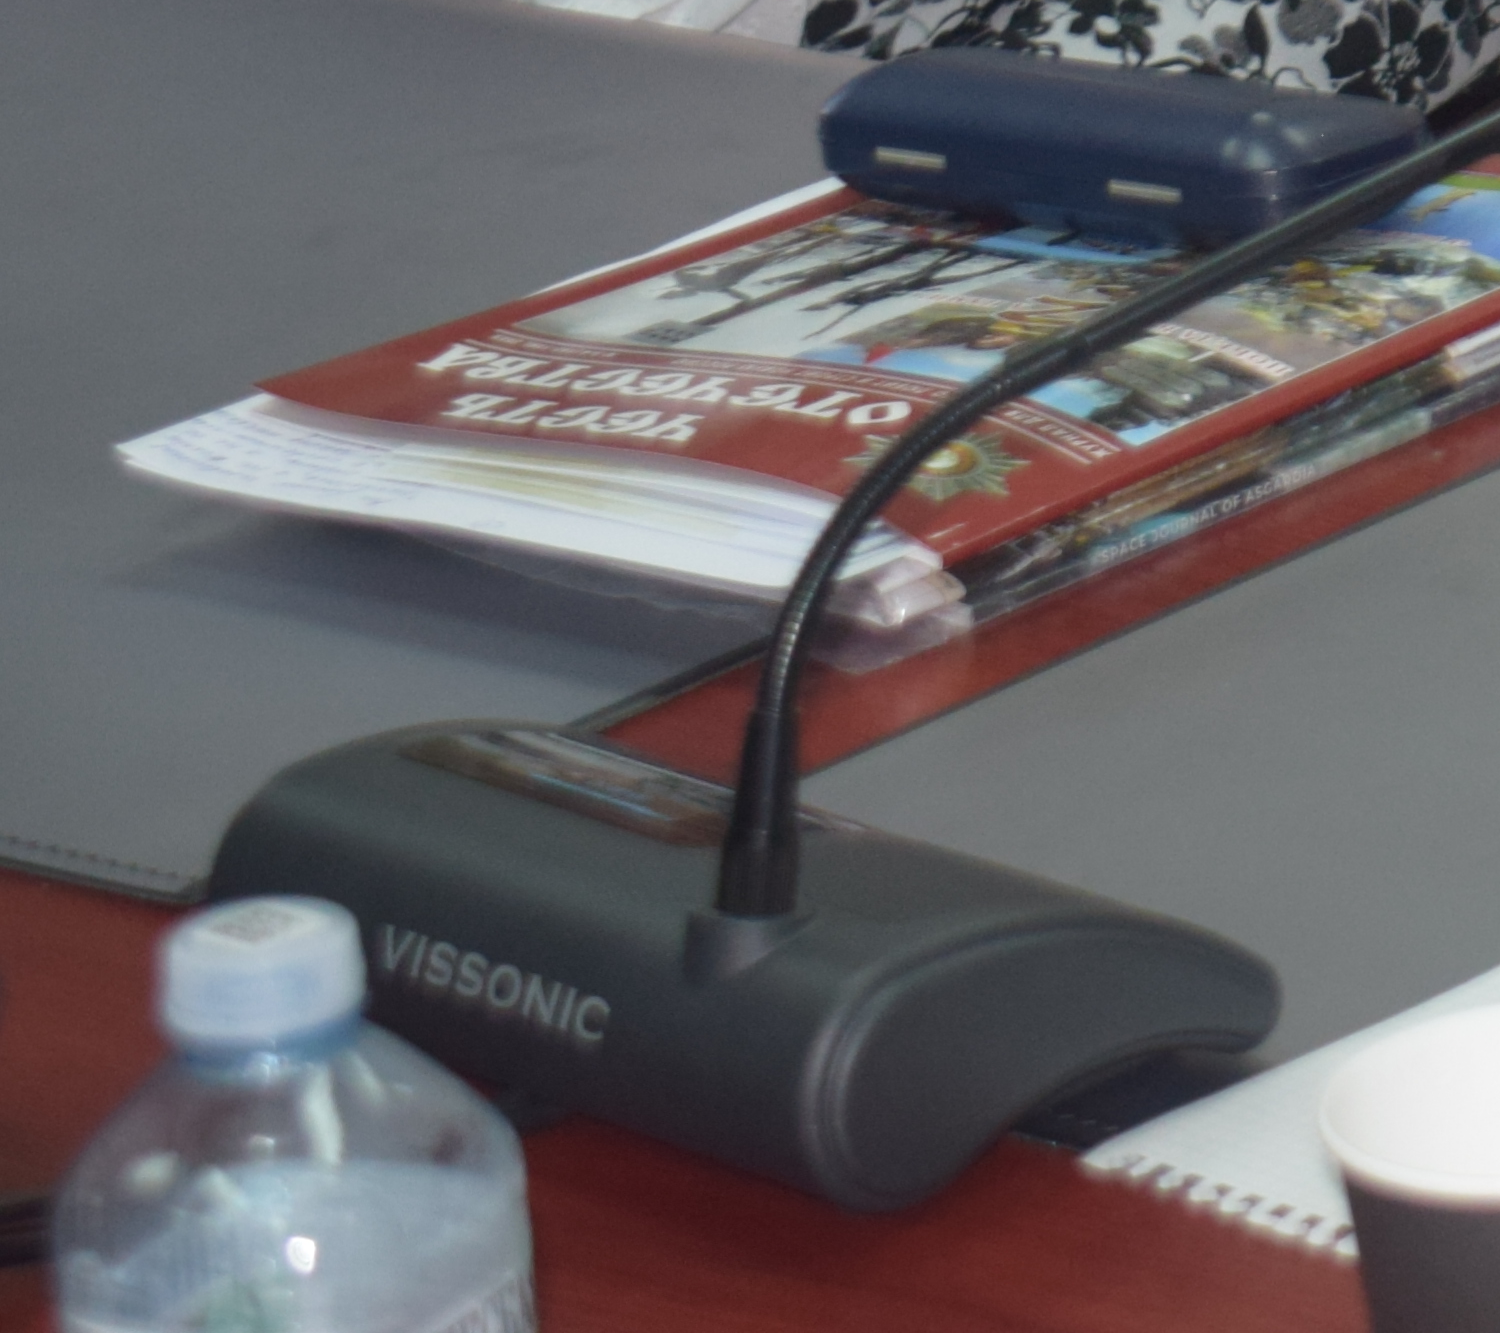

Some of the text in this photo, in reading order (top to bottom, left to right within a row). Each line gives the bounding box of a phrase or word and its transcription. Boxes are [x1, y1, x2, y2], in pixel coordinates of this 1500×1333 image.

[417, 342, 912, 426] ОТЕЧЕСТВА
[440, 391, 707, 443] ЧЕСТЬ
[1100, 464, 1317, 564] SPACE JOURNAL OF ASGARDIA
[383, 923, 612, 1041] VISSONIC
